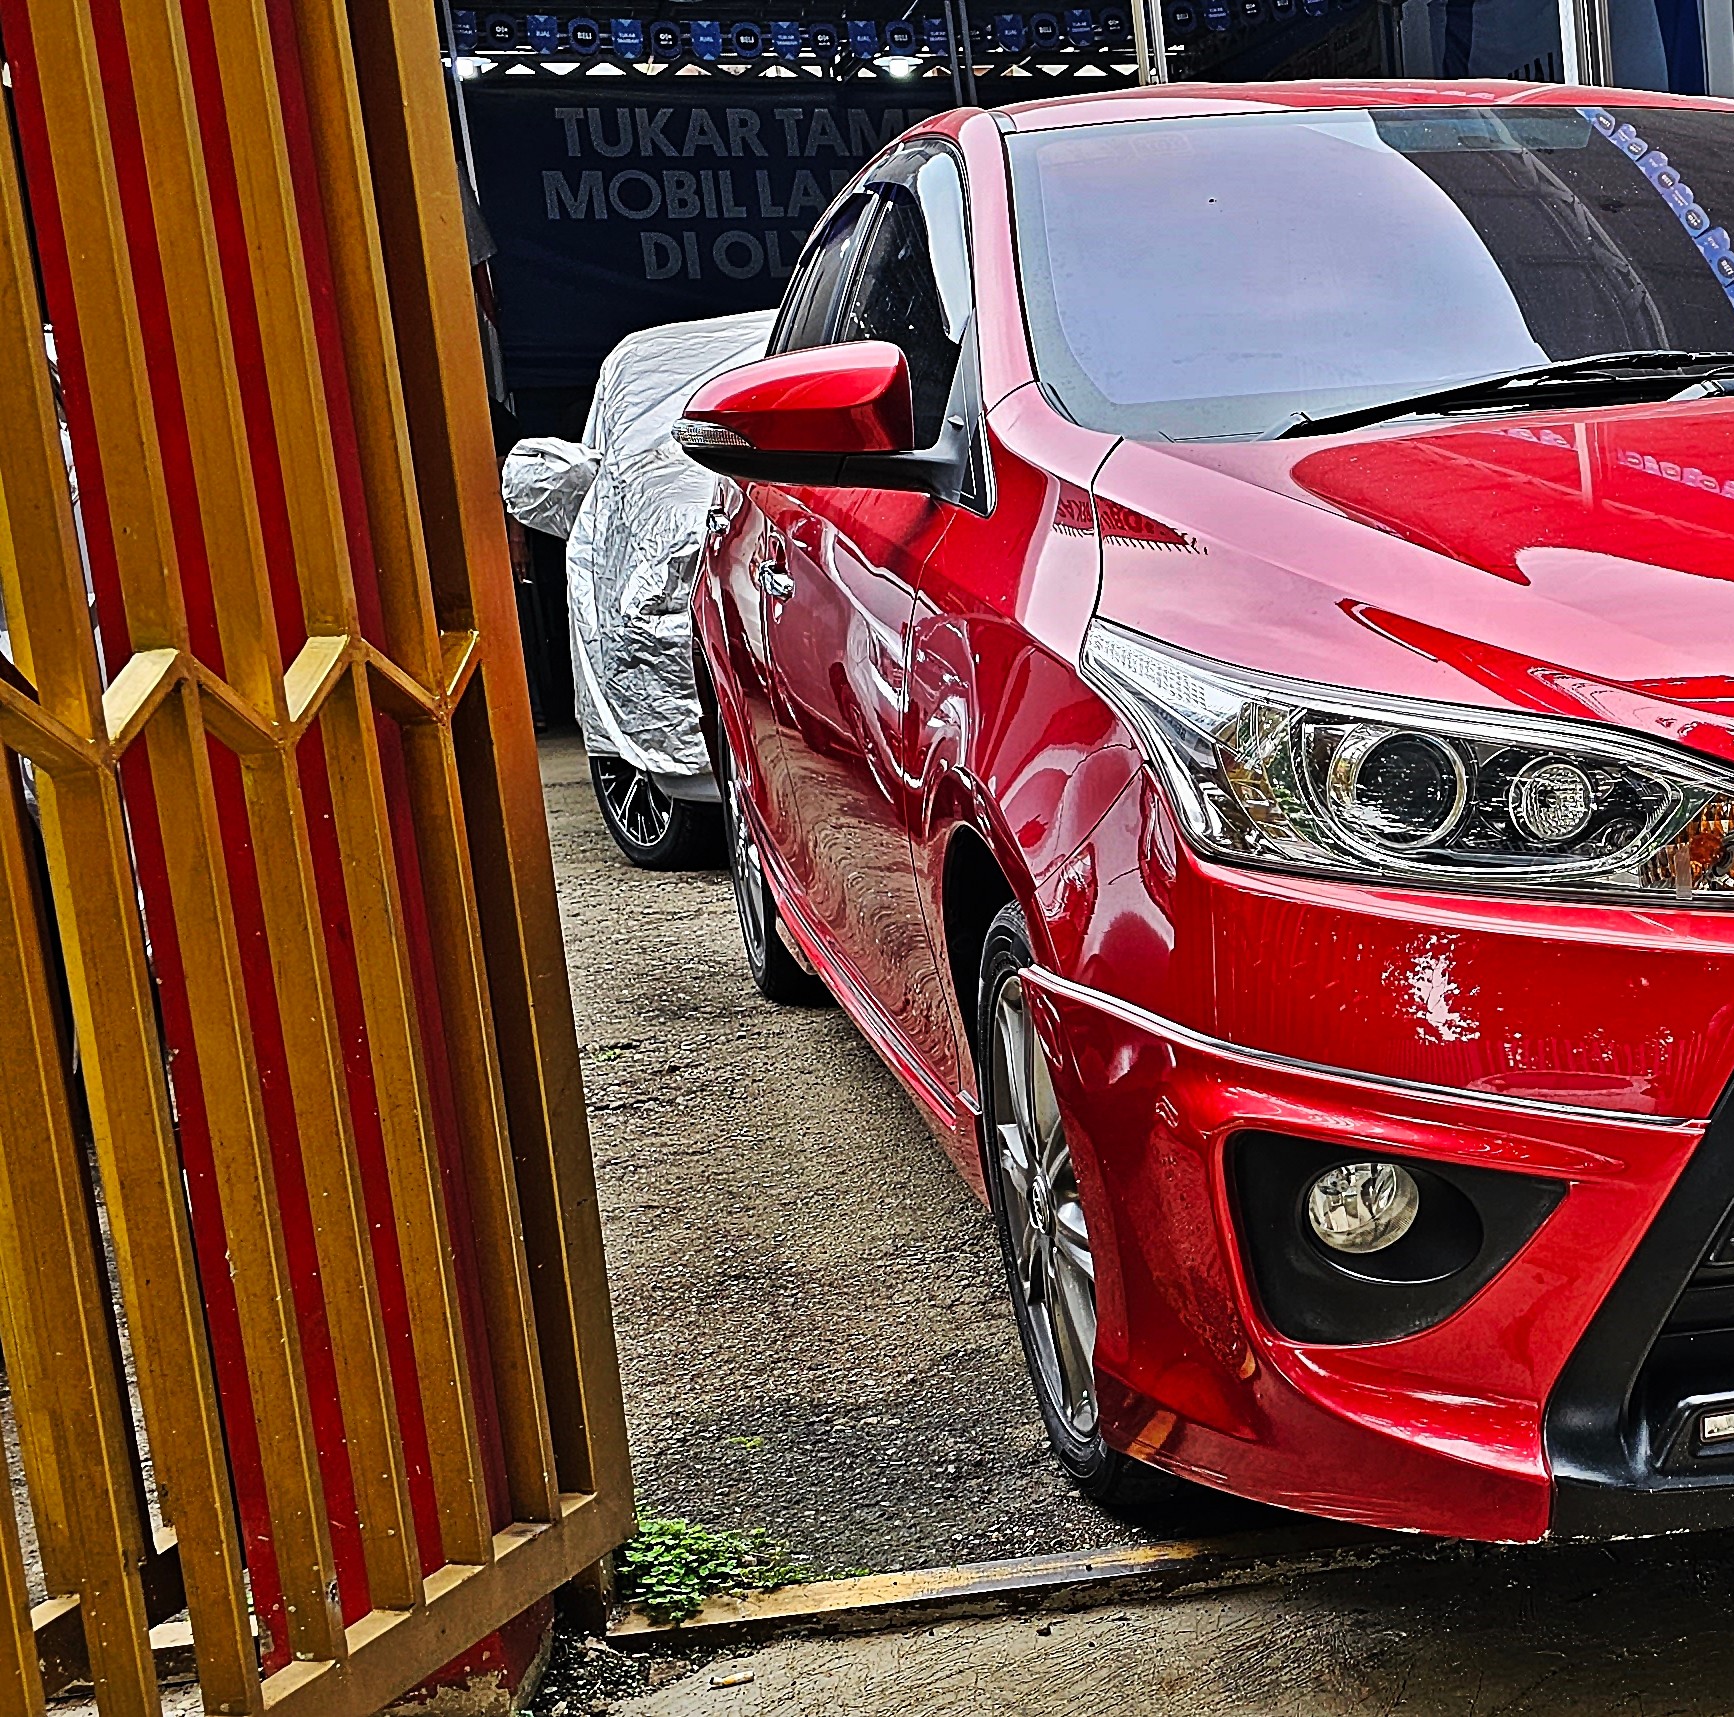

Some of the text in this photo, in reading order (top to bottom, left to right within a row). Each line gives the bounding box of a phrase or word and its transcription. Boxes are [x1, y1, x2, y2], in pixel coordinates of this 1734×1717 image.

[555, 107, 769, 158] TUKAR
[541, 169, 748, 221] MOBIL
[640, 230, 702, 281] DI
